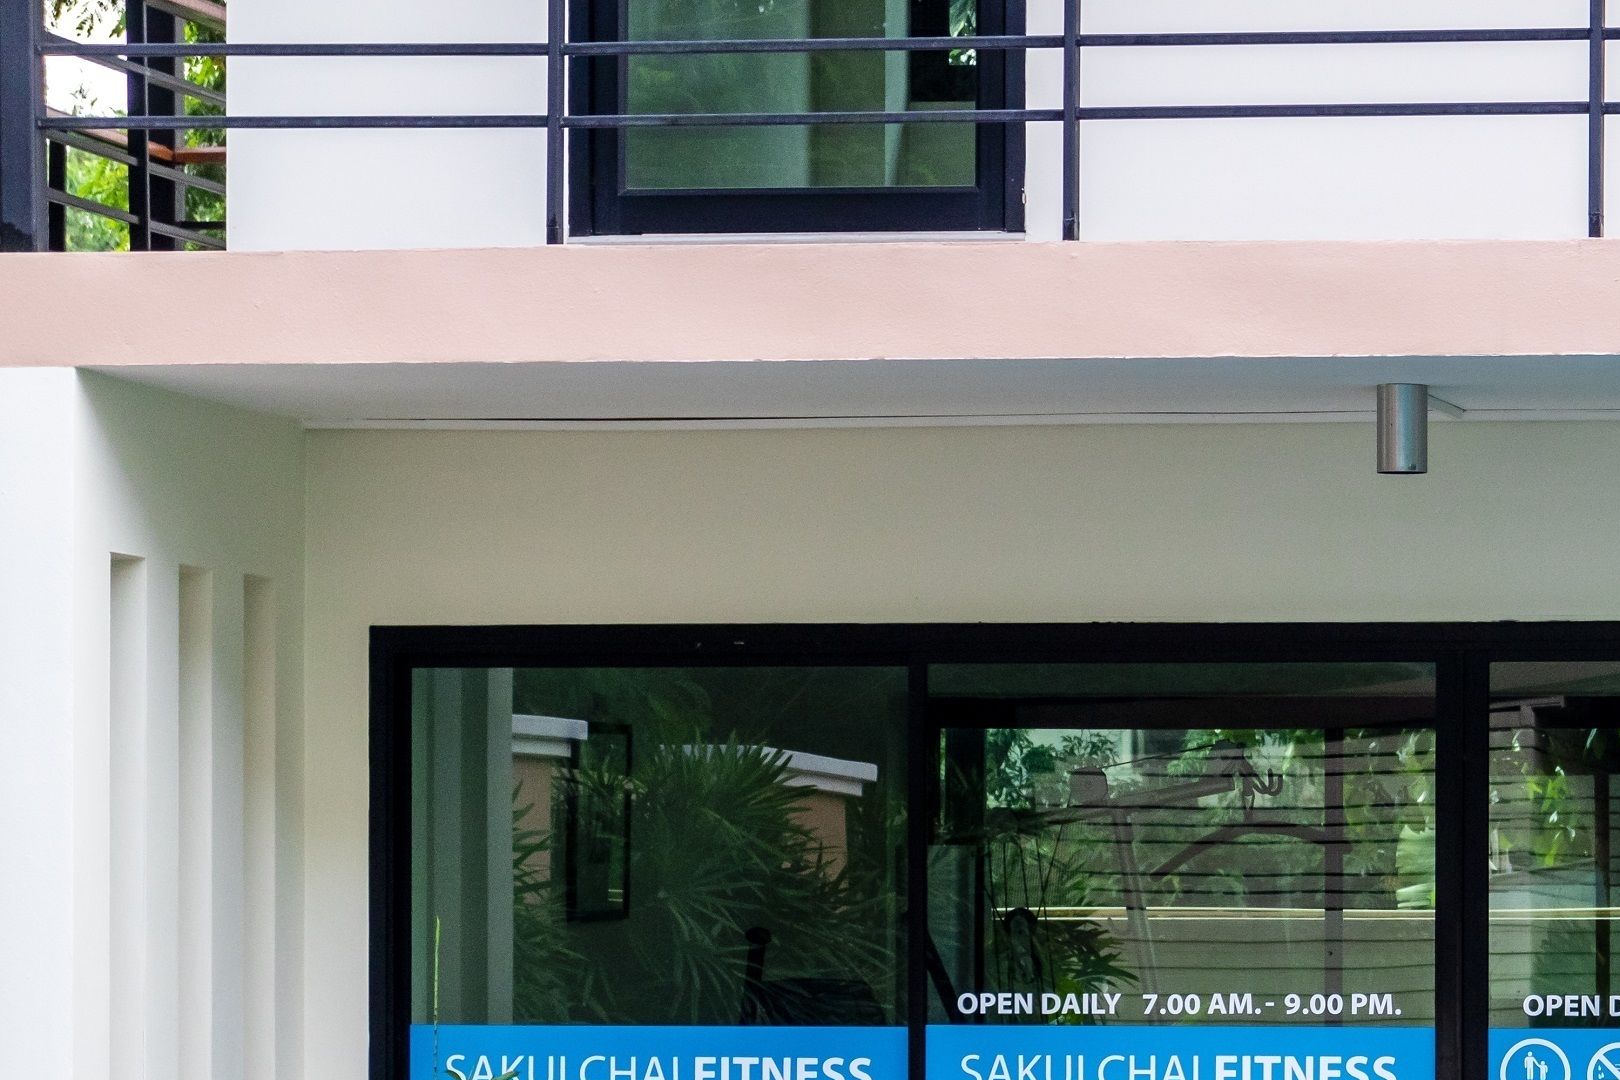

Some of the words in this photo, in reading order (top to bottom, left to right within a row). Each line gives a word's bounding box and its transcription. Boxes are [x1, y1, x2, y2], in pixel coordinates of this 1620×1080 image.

[957, 992, 1033, 1015] OPEN
[1041, 992, 1122, 1015] DAILY
[1142, 992, 1201, 1016] 7.00
[1284, 992, 1344, 1016] 9.00
[1351, 992, 1403, 1016] PM.
[1522, 994, 1600, 1018] OPEN
